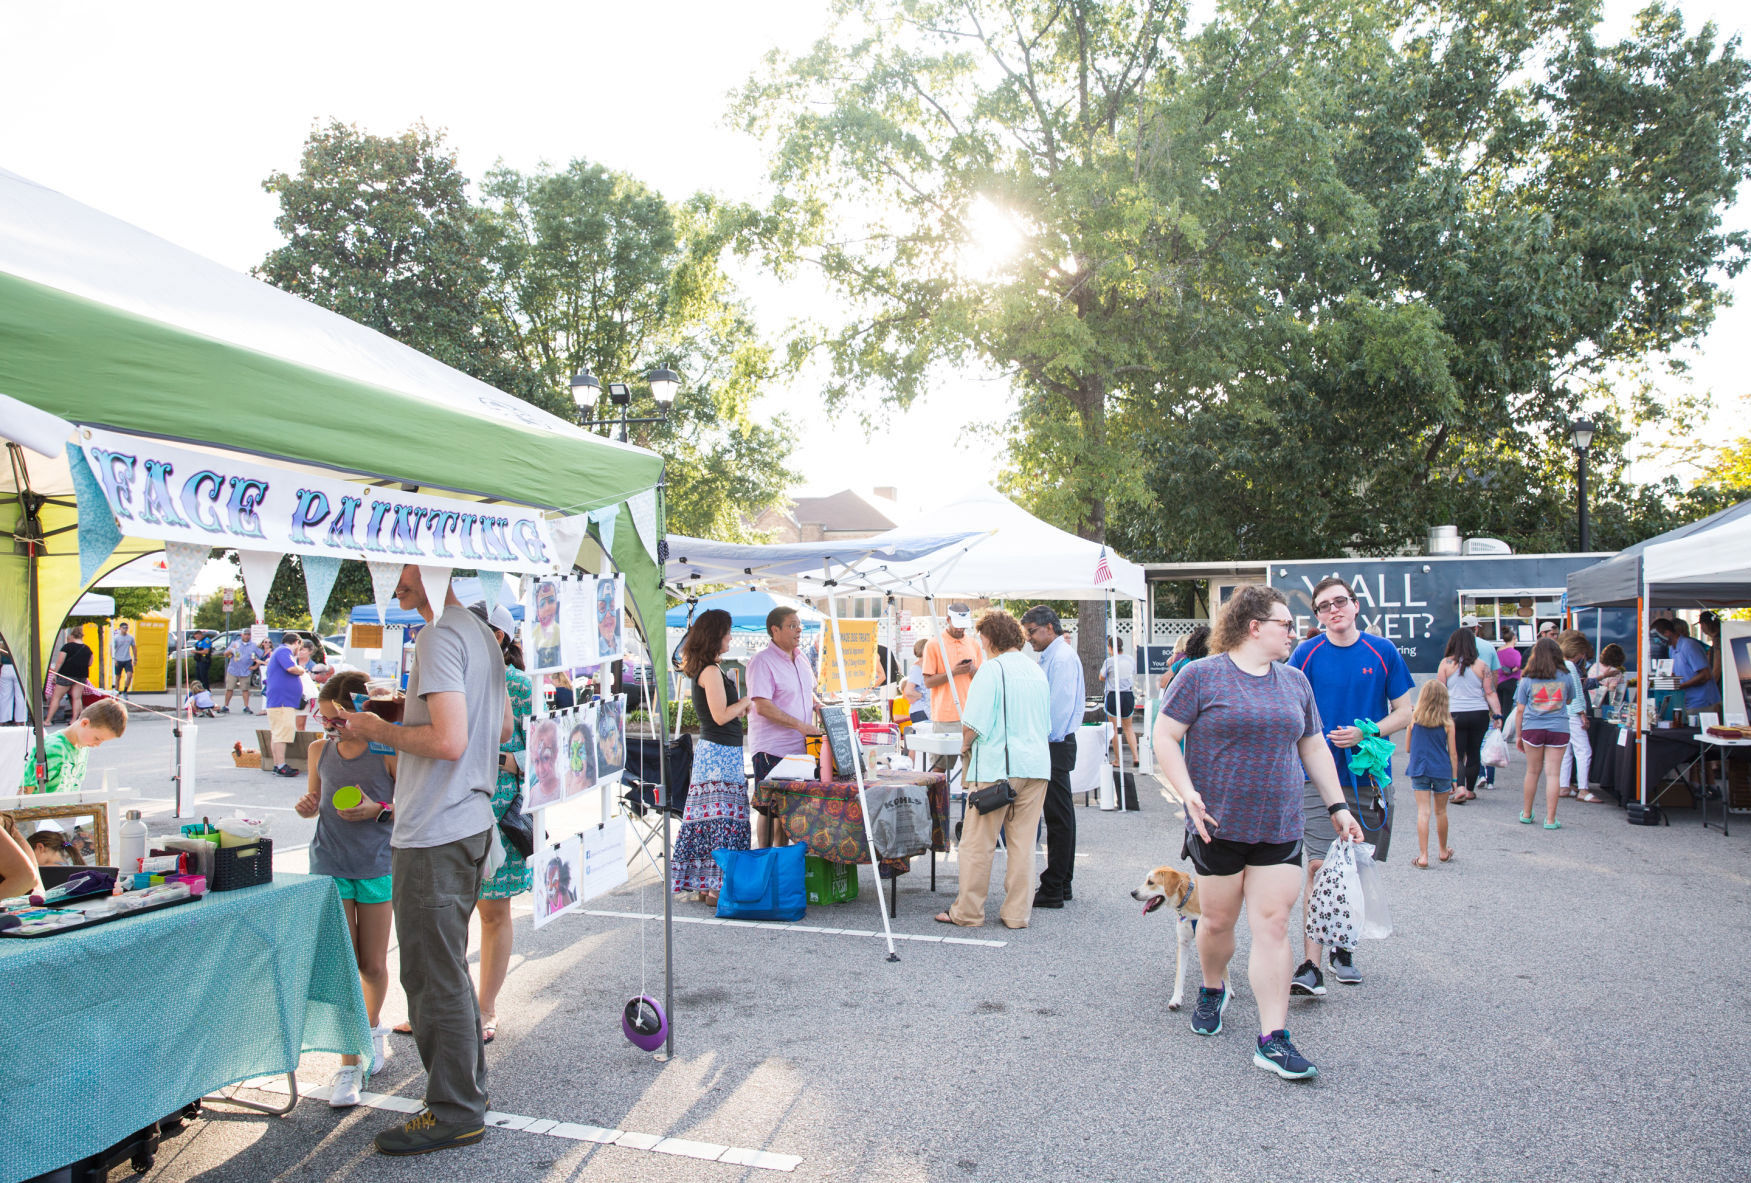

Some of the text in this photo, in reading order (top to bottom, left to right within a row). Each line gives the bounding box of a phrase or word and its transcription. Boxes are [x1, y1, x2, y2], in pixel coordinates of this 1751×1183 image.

[90, 447, 551, 564] FACE PAINTING
[1361, 612, 1435, 639] YET?
[1396, 645, 1417, 658] ring
